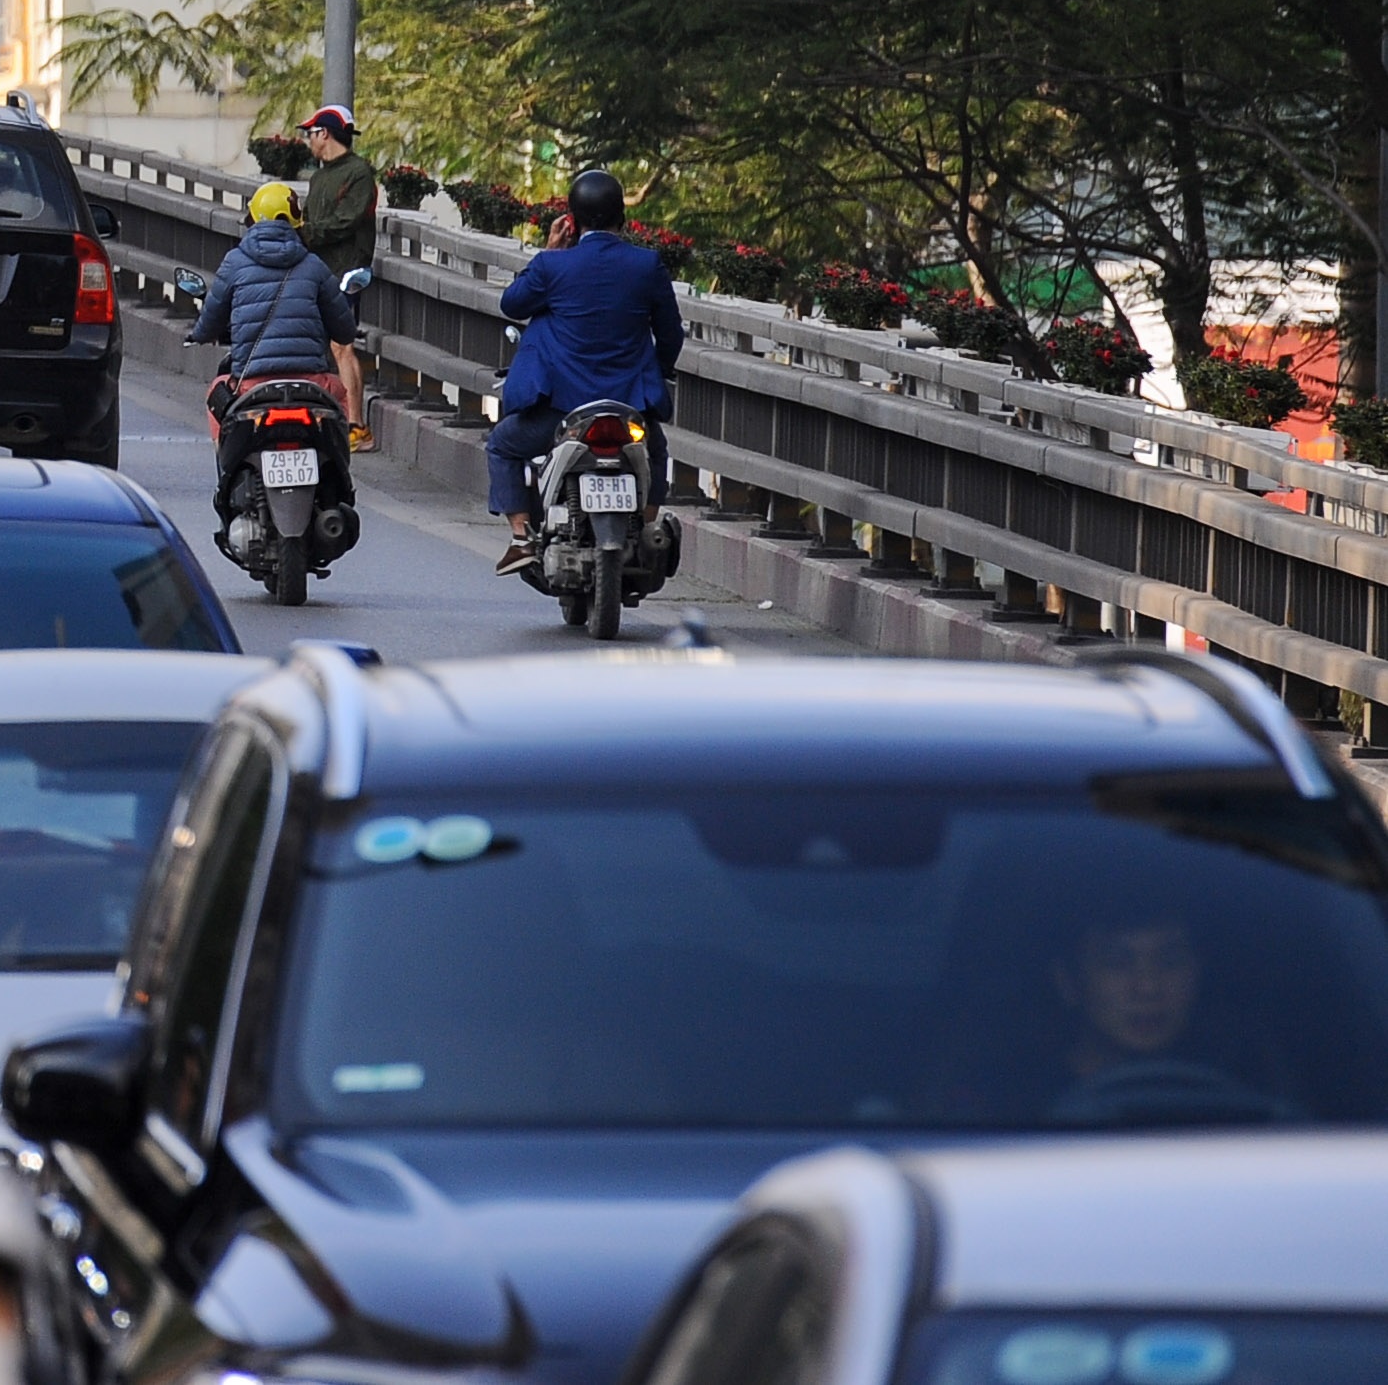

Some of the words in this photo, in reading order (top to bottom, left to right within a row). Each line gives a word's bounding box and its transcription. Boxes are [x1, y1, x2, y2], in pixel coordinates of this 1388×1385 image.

[270, 451, 309, 469] 29-P2
[267, 467, 314, 484] 036.07
[589, 477, 627, 493] 38-H1
